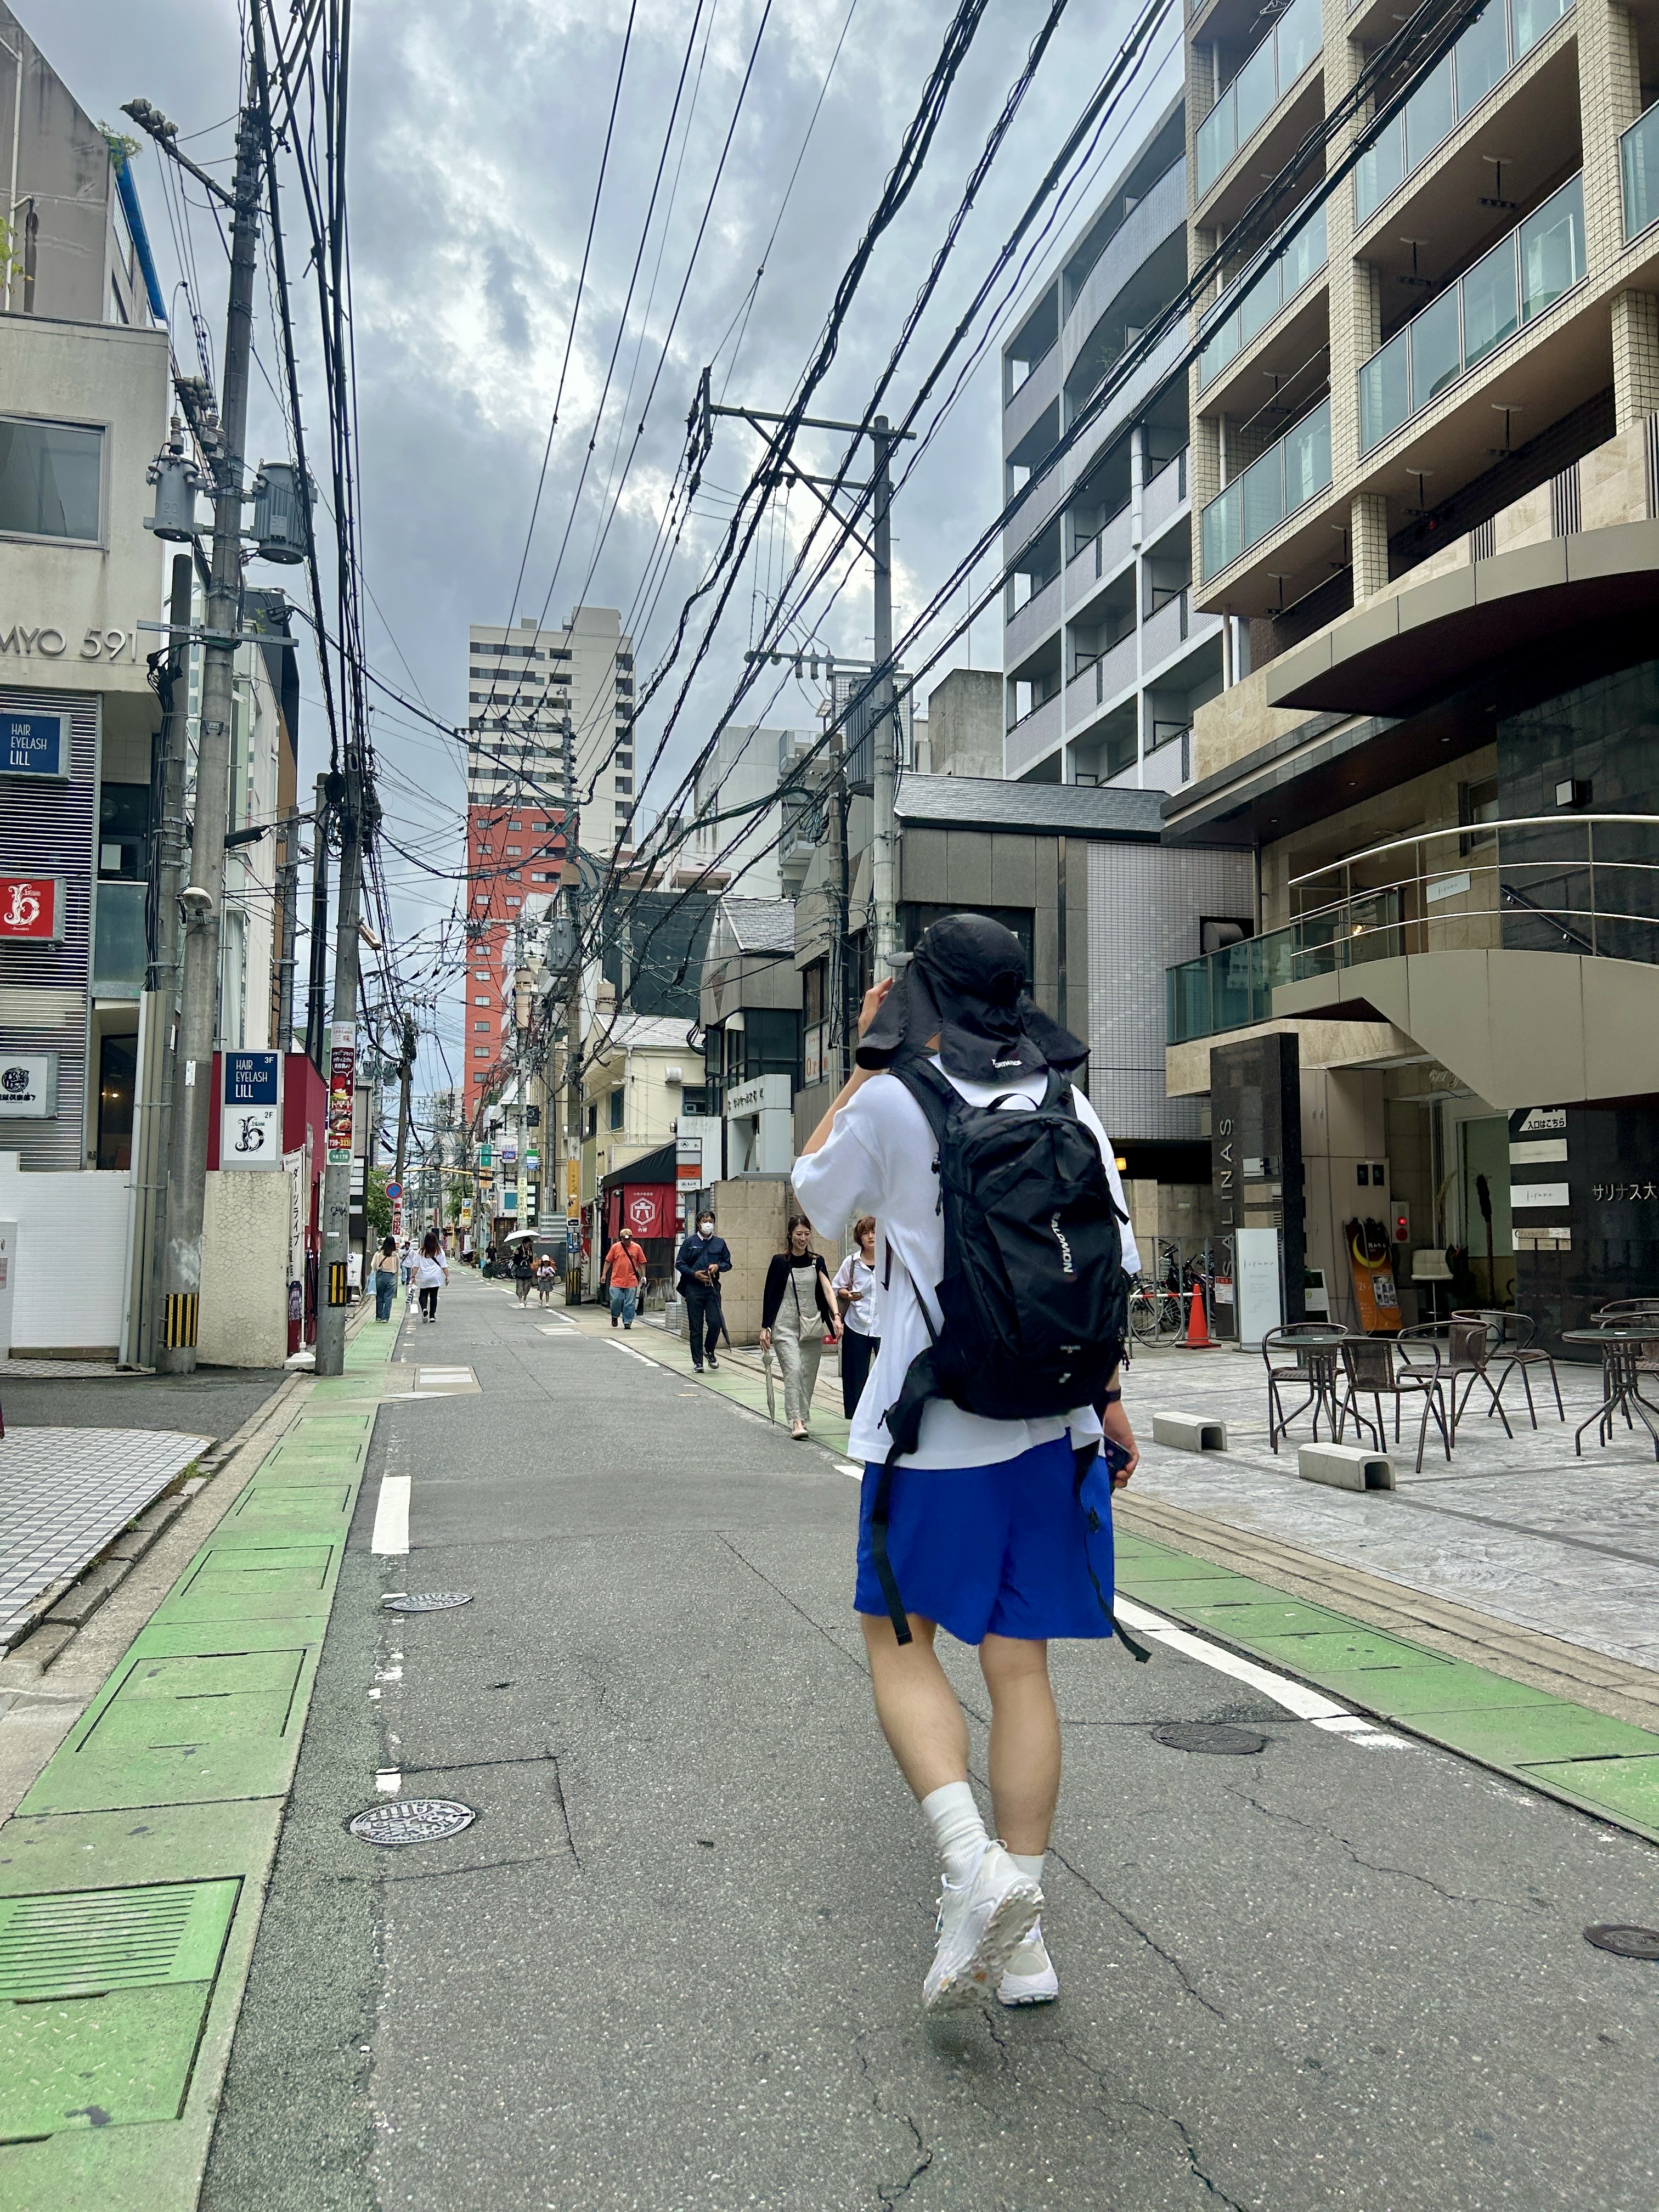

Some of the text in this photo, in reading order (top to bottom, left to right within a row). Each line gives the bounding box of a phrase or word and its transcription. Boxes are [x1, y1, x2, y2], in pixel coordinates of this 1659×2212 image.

[80, 627, 137, 662] 591
[11, 723, 31, 736] HAIR
[10, 736, 47, 751] EYELASH
[10, 750, 31, 766] LILL
[236, 1059, 253, 1070] HAIR
[236, 1071, 268, 1082] EYELASH
[235, 1084, 254, 1098] LILL
[331, 1100, 352, 1109] トマト
[1527, 1118, 1565, 1130] 入口はこちら
[1220, 1118, 1234, 1277] SALINAS
[1592, 1181, 1658, 1201] サリナス大
[1050, 1211, 1074, 1274] SALOMON
